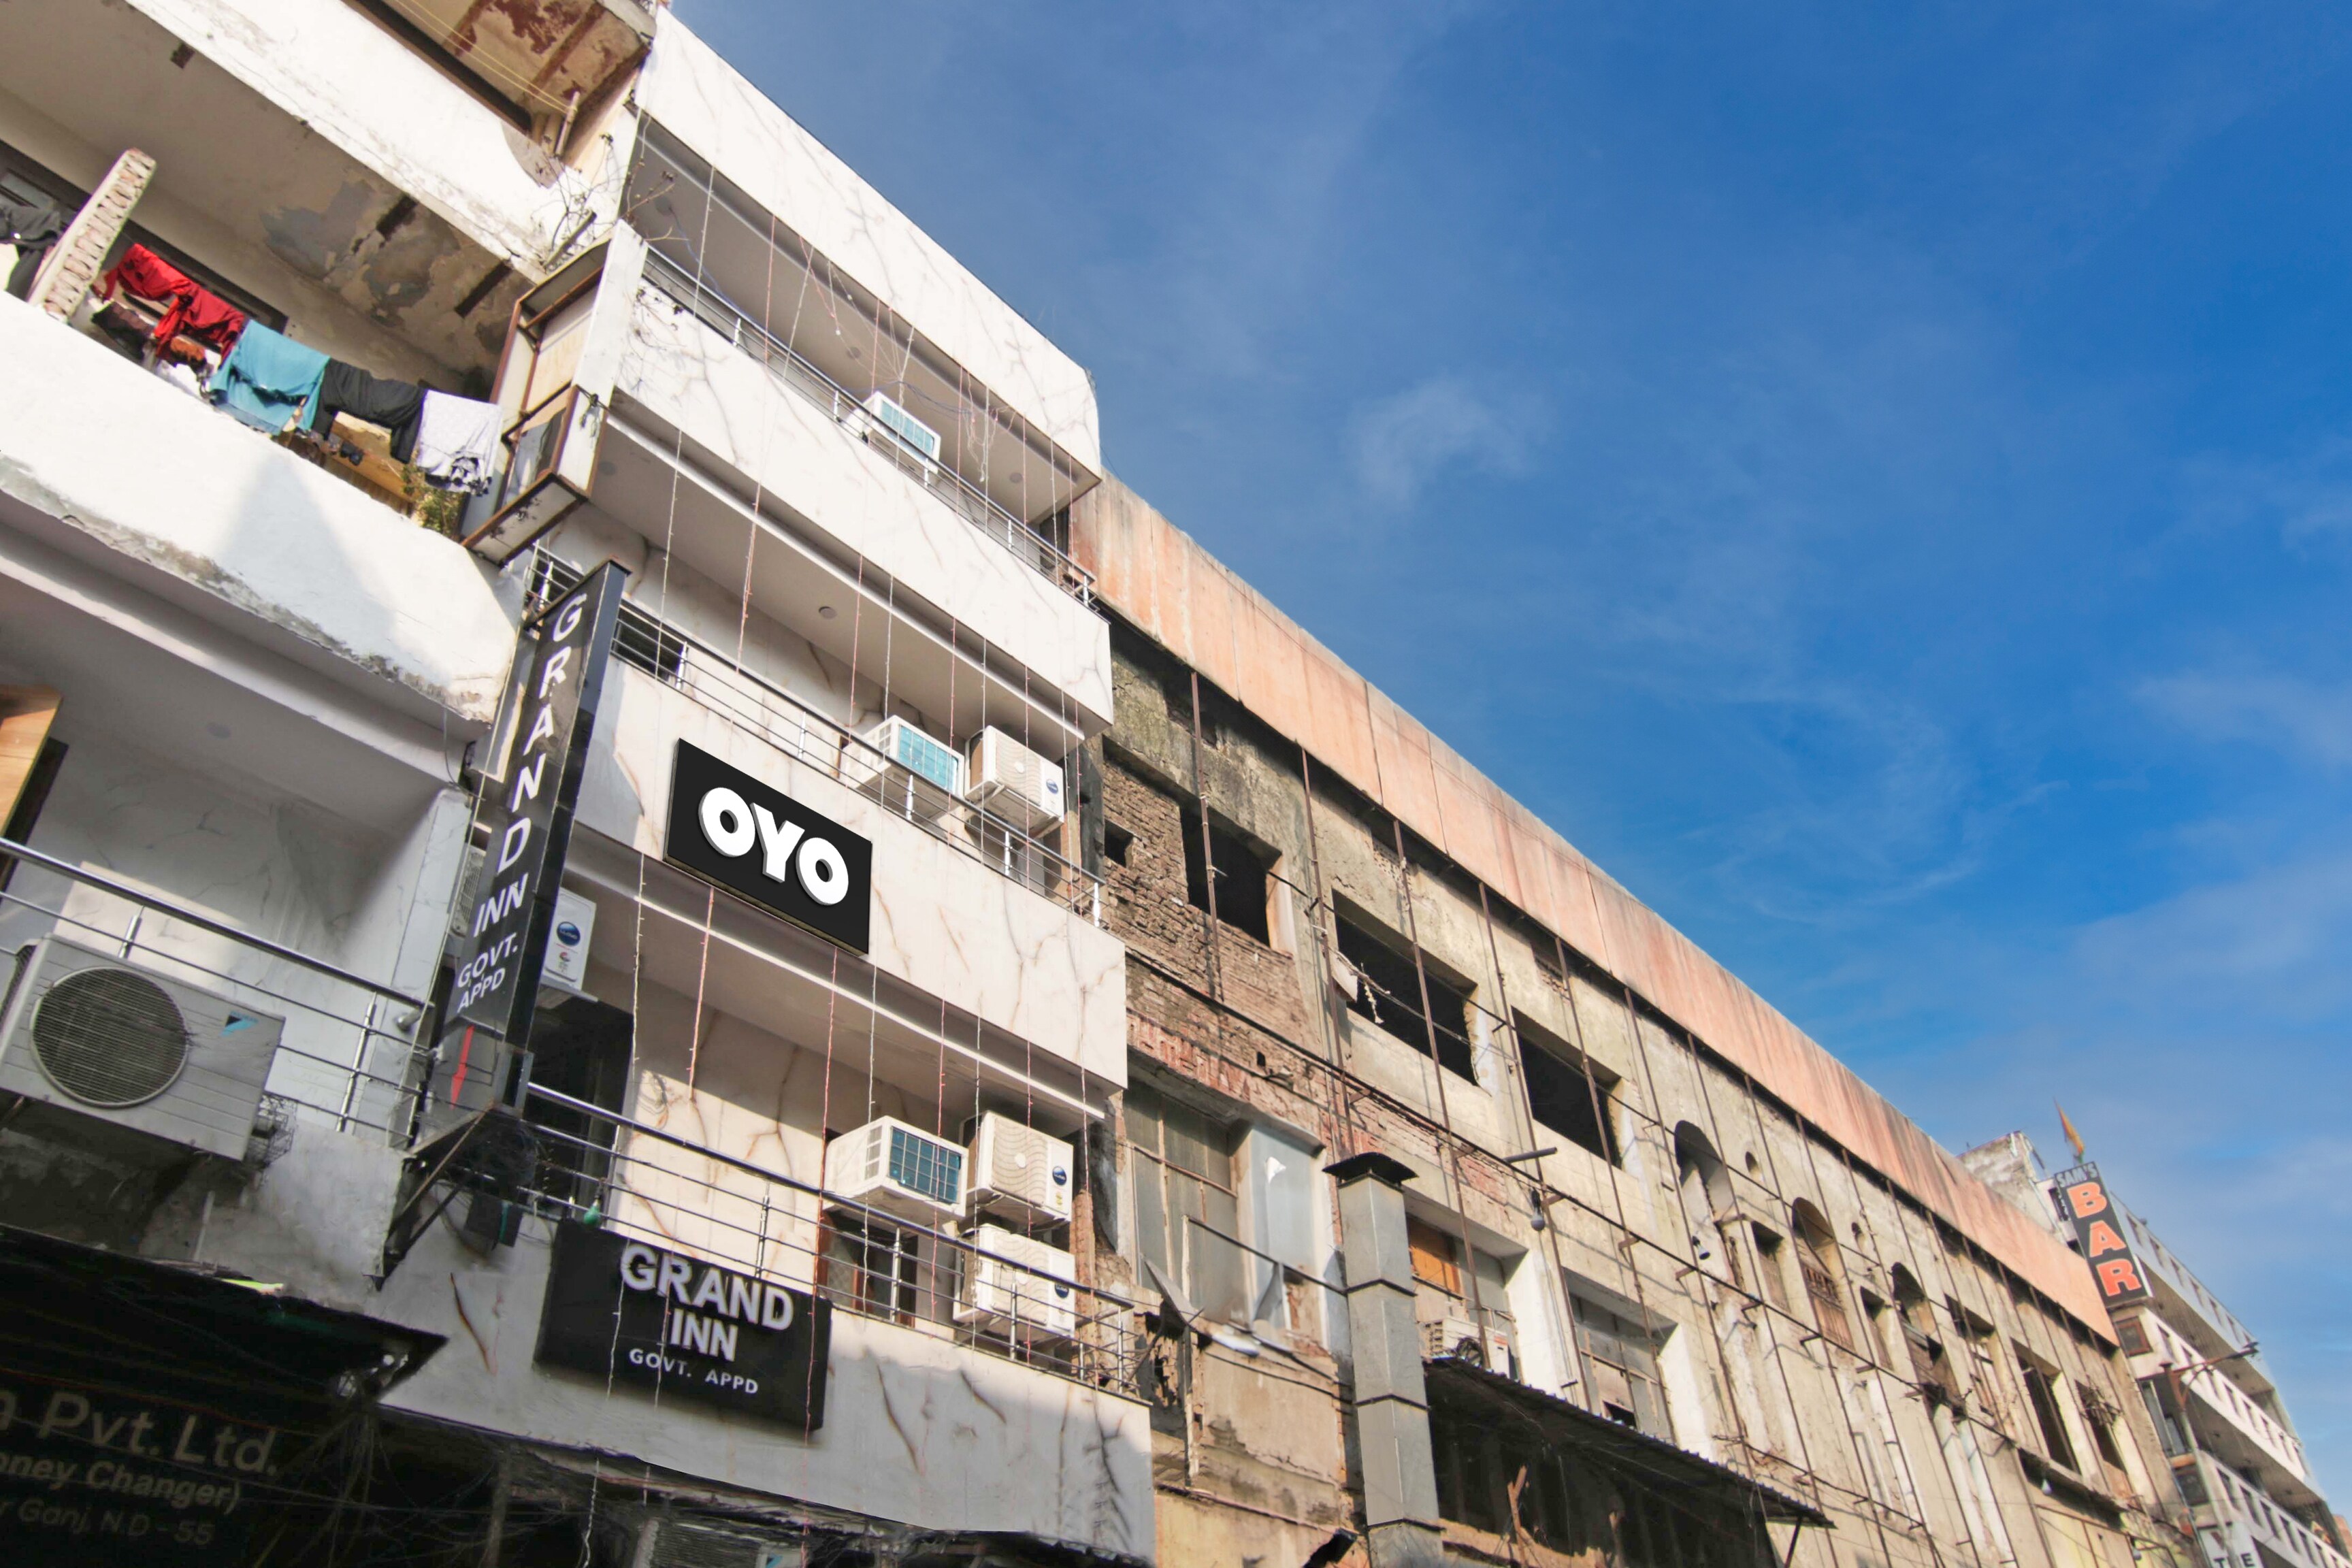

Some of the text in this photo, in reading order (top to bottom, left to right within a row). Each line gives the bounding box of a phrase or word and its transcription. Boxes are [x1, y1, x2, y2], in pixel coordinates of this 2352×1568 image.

[474, 593, 587, 937] GRAND INN
[698, 787, 849, 906] OYO
[457, 932, 518, 988] GOVT.
[457, 968, 506, 1013] APPD
[2056, 1162, 2098, 1188] SAM'S
[2066, 1181, 2142, 1297] BAR
[620, 1243, 795, 1331] GRAND
[670, 1309, 738, 1361] INN
[629, 1348, 759, 1394] GOVT. APPD
[37, 1390, 161, 1456] Pvt.
[172, 1414, 278, 1477] Ltd.
[86, 1460, 241, 1514] Changer)
